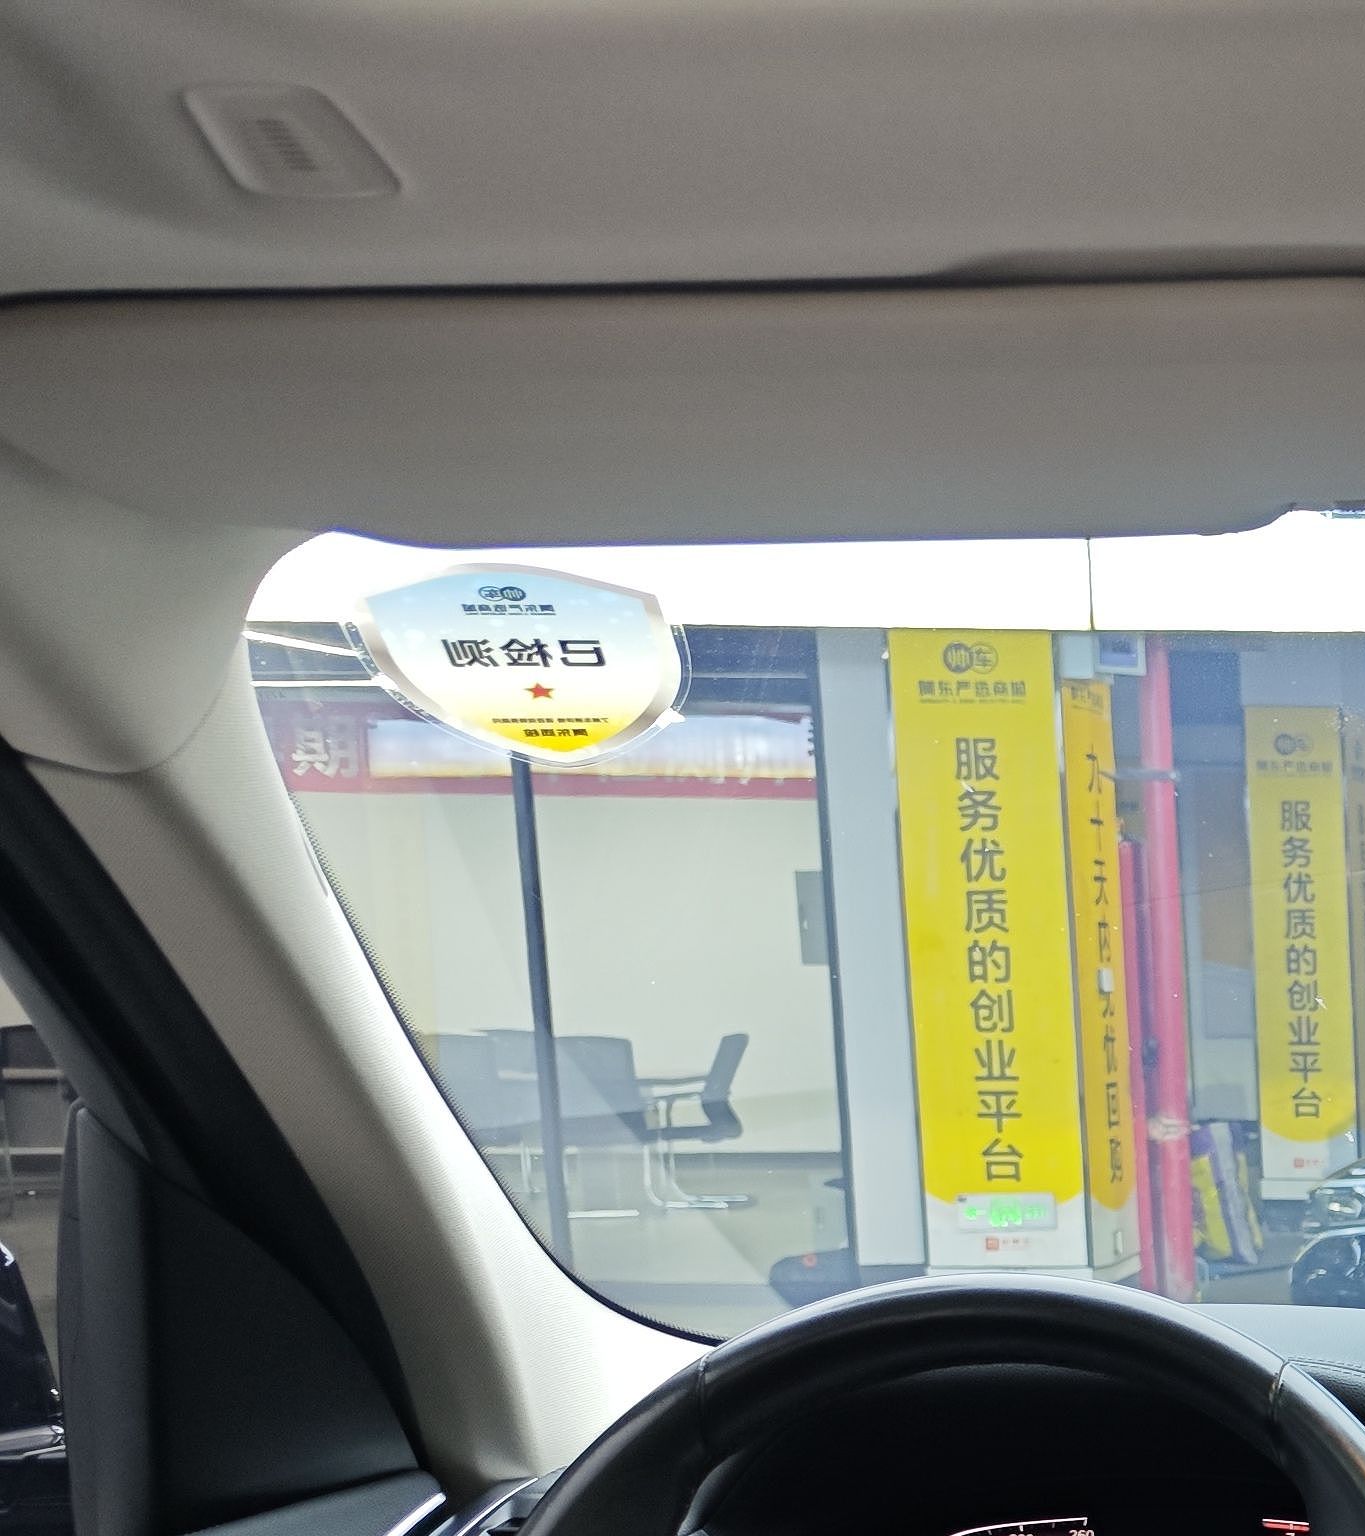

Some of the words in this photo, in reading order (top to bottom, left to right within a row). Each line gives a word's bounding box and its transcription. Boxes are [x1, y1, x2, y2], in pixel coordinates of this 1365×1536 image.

[955, 737, 1024, 1182] 服务优质的创业平台
[1279, 800, 1323, 1119] 服务优质的创业平台
